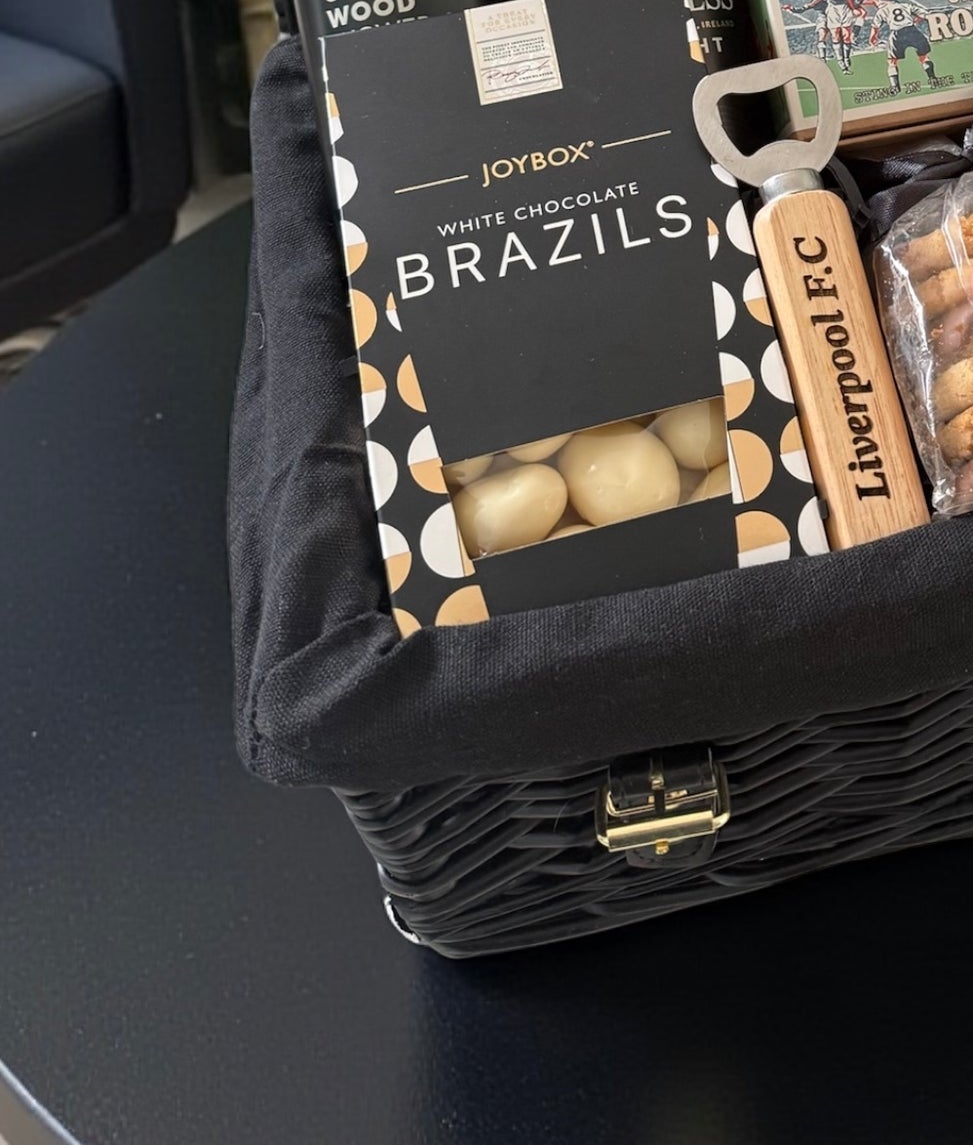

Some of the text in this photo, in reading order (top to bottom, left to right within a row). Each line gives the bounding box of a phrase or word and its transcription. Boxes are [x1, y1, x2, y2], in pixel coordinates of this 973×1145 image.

[892, 8, 905, 22] 8
[854, 87, 900, 104] STING
[904, 81, 921, 94] IN
[928, 75, 954, 90] THE
[437, 181, 640, 237] WHITE CHOCOLATE
[396, 194, 692, 300] BRAZILS
[812, 309, 891, 503] Liverpool
